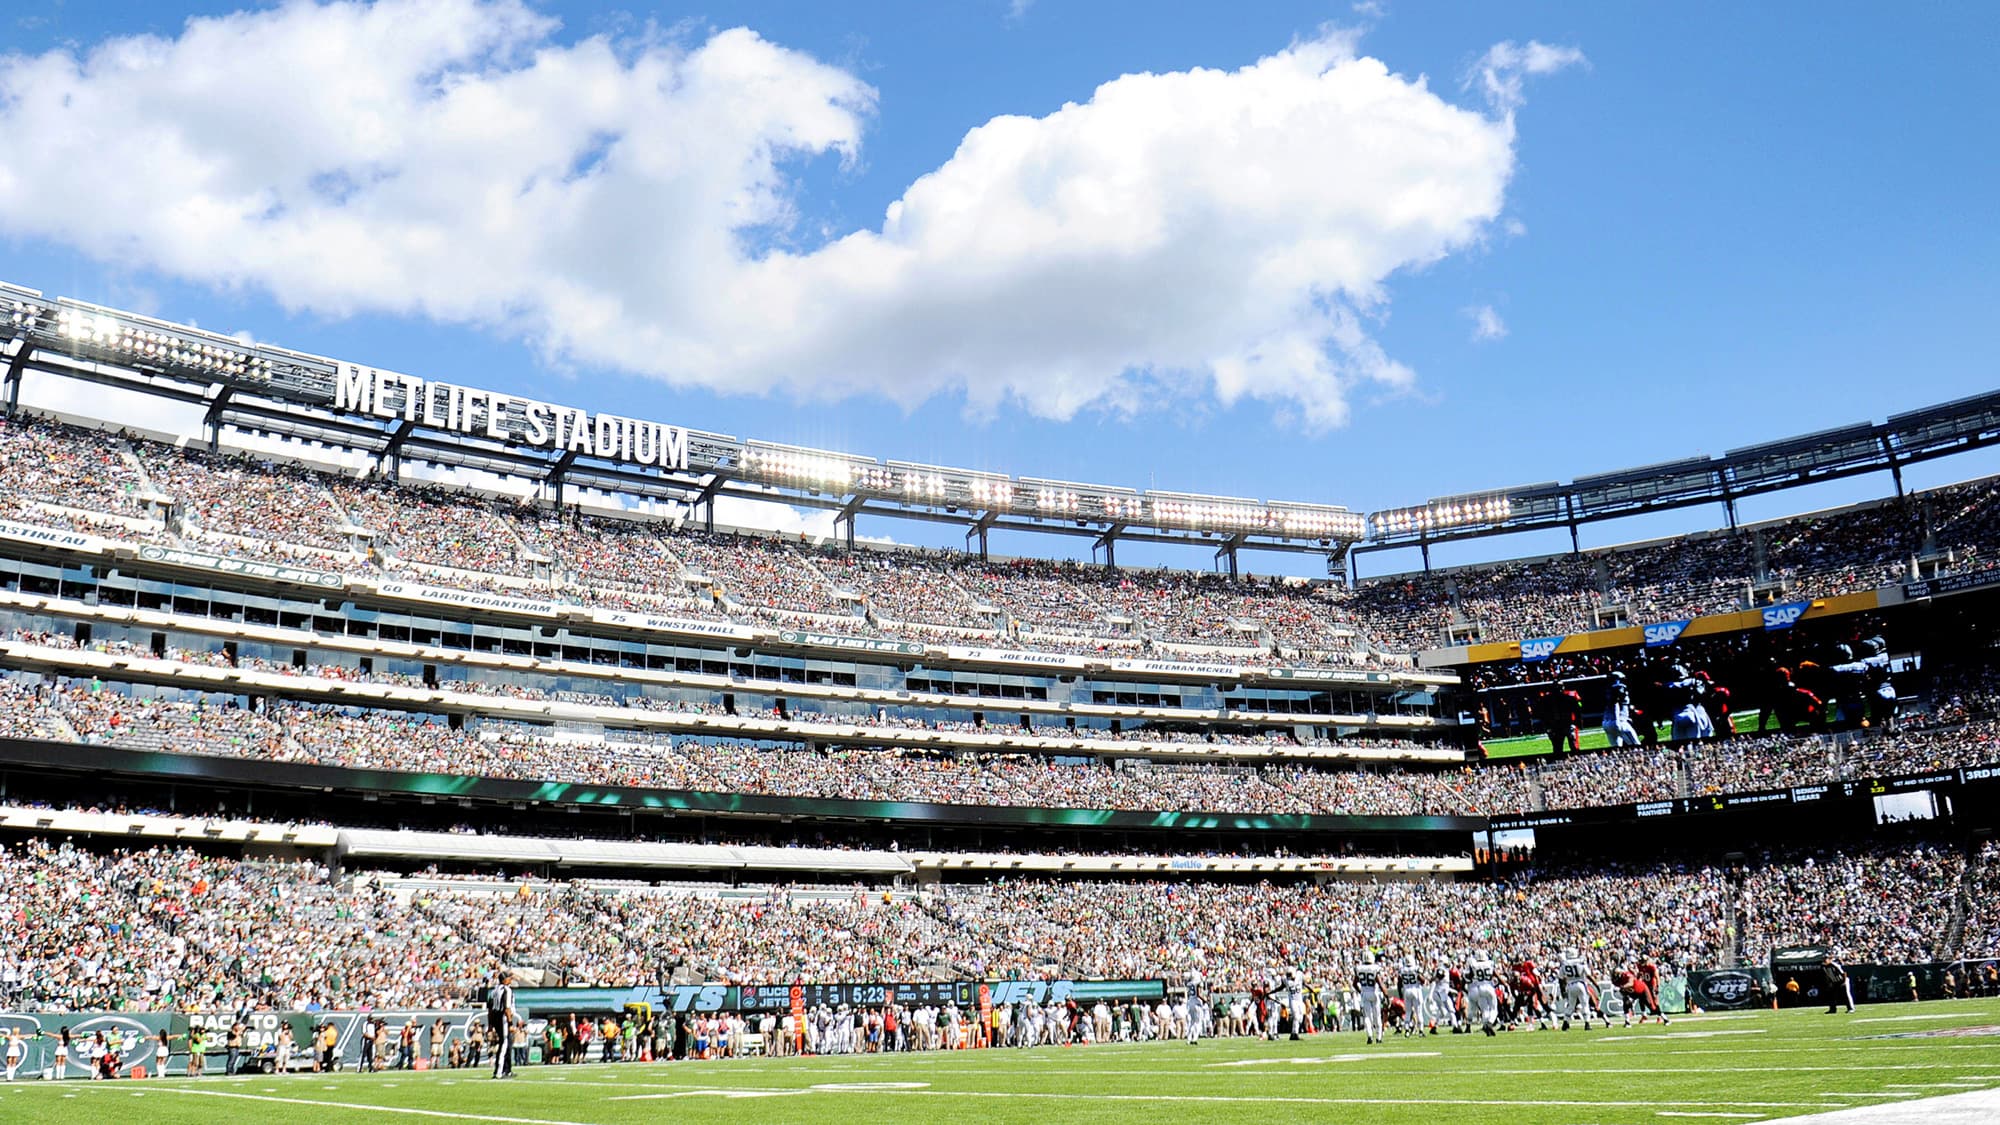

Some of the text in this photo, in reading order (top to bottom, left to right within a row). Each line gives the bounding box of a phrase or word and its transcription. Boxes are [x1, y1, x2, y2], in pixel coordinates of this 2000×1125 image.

[334, 363, 689, 470] METLIFE STADIUM
[164, 551, 321, 583] HOME OF THE JETS
[420, 589, 469, 603] LARRY
[470, 596, 552, 613] GRANTHAM
[1763, 606, 1802, 627] SAP
[611, 614, 736, 635] 75 WINSTON HILL
[1644, 624, 1682, 645] SAP
[804, 635, 836, 646] PLAY
[866, 640, 877, 649] A
[876, 642, 901, 651] JET
[1521, 640, 1554, 659] SAP
[1000, 653, 1023, 661] JOE
[1023, 655, 1066, 664] KLECKO
[1145, 663, 1194, 672] FREEMAN
[1966, 769, 1991, 780] 3RD
[1636, 801, 1673, 811] SEAHAWKS
[1637, 808, 1672, 817] PANTHERS
[1476, 968, 1492, 981] 95
[1564, 966, 1579, 978] 91
[1358, 972, 1376, 986] 26
[1401, 974, 1416, 984] 52
[758, 987, 790, 997] BUCS
[852, 987, 885, 1003] 5:23
[896, 992, 917, 1000] 3RD
[961, 988, 969, 1000] 9
[758, 997, 790, 1007] JETS
[829, 993, 839, 1004] 3
[249, 1014, 279, 1030] TO
